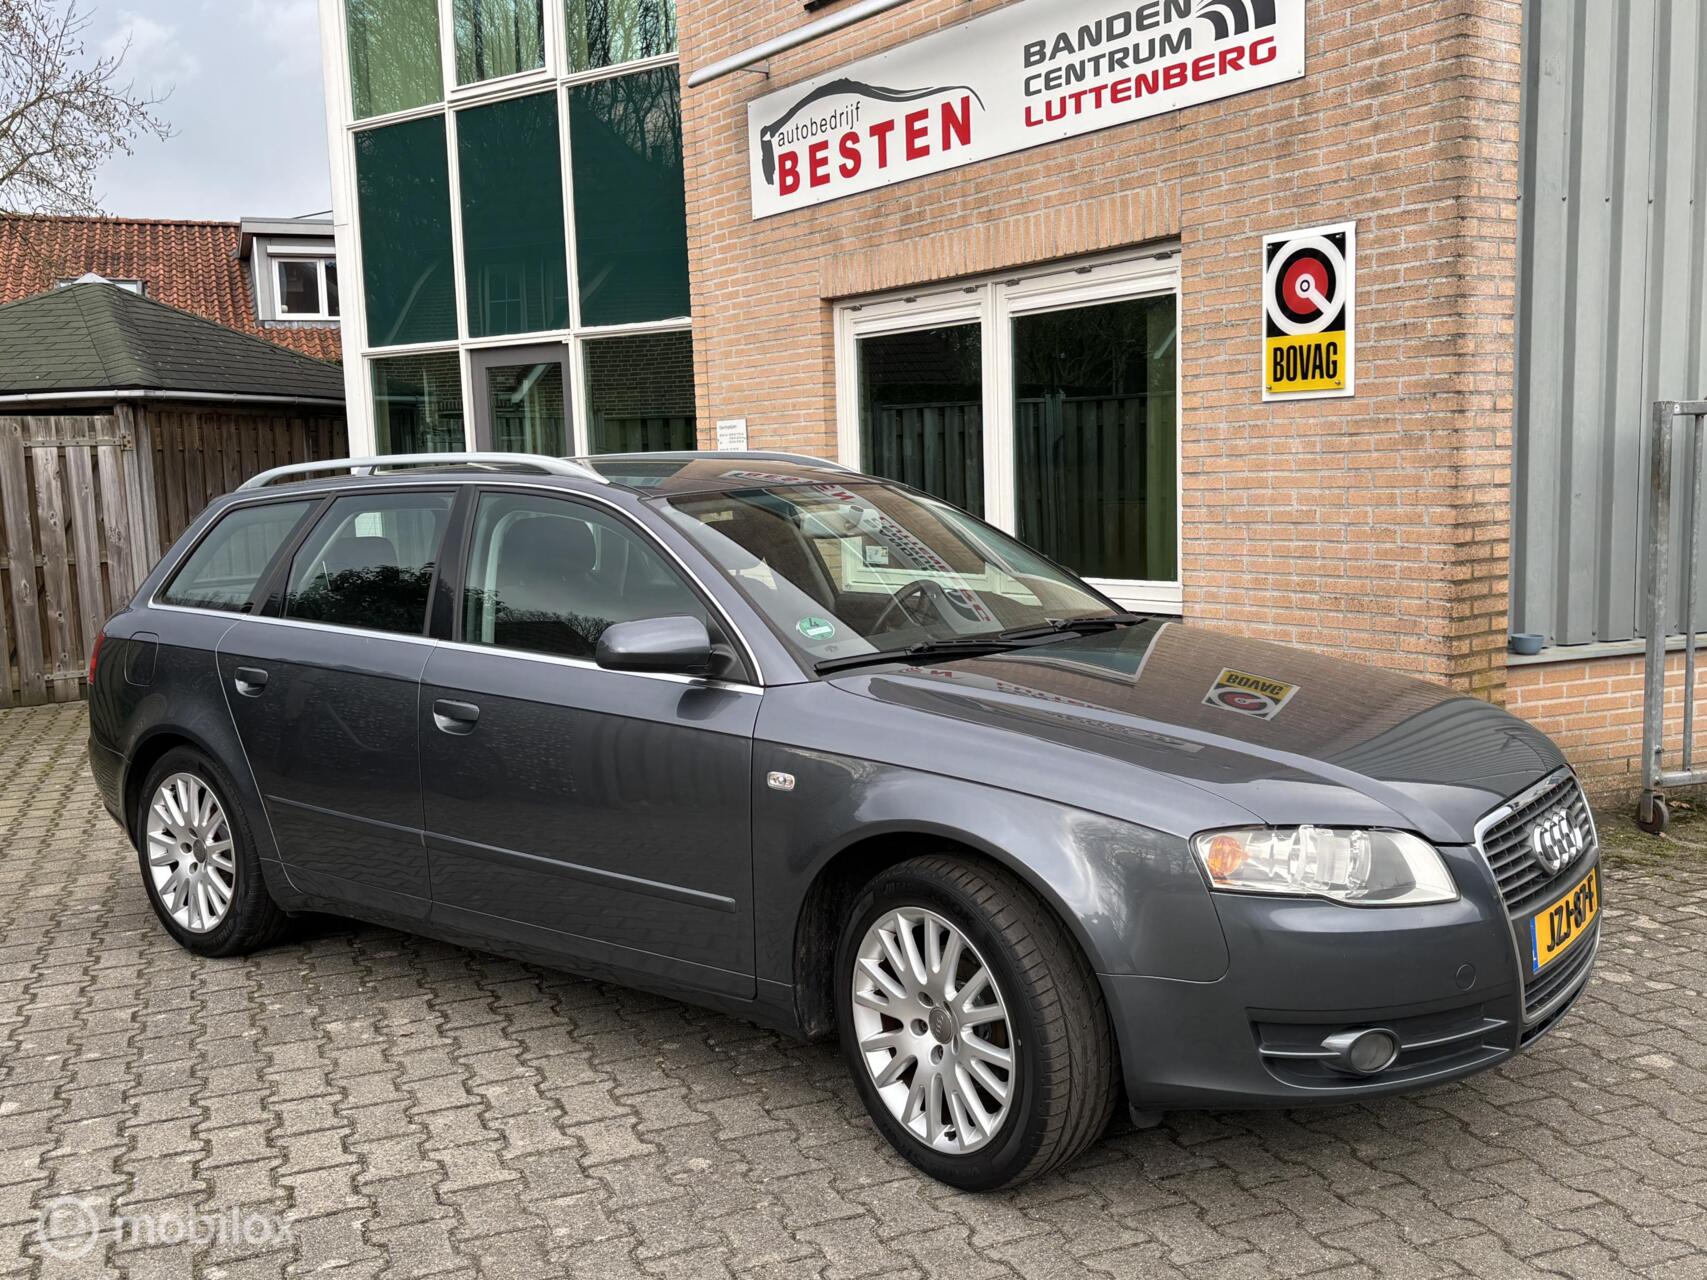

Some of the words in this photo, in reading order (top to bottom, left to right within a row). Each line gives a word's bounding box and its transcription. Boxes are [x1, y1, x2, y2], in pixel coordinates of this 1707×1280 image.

[1024, 0, 1192, 68] BANDEN
[1024, 27, 1192, 97] CENTRUM
[1025, 36, 1277, 127] LUTTENBERG
[778, 101, 861, 147] autobedrijf
[778, 95, 971, 196] BESTEN
[1273, 342, 1338, 382] BOVAG
